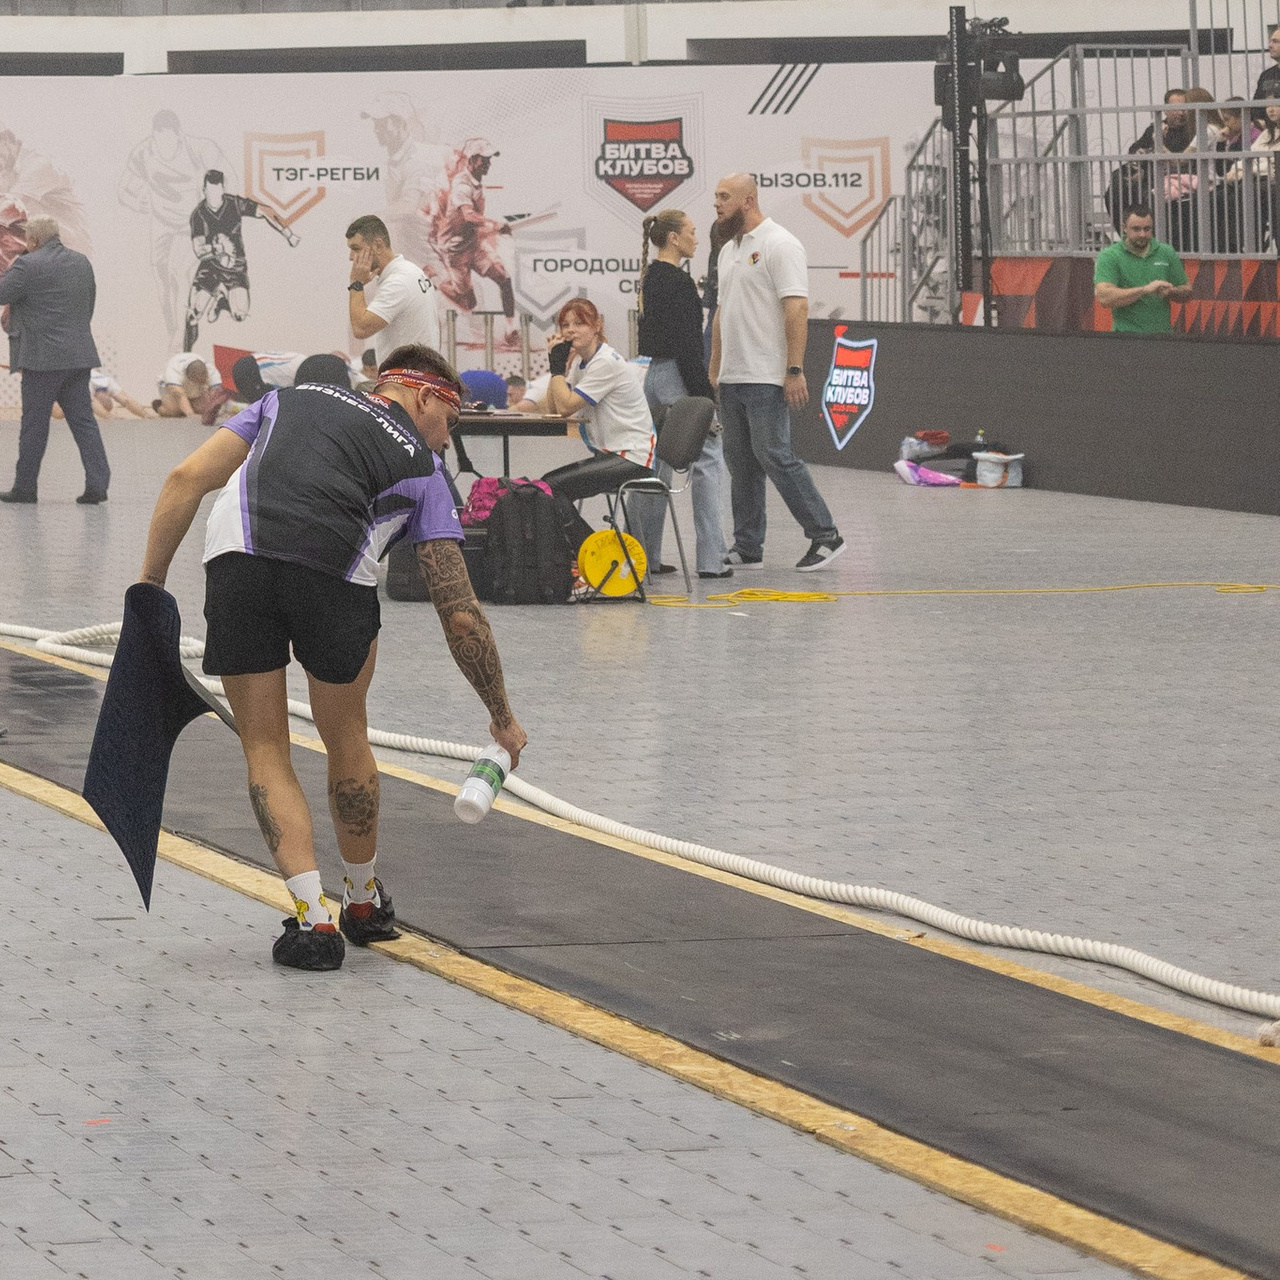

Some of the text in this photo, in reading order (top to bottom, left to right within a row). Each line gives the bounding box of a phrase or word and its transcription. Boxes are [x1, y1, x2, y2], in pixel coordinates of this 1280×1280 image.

[604, 142, 683, 159] БИТВА
[272, 166, 380, 182] ТЭГ-РЕГБИ
[598, 159, 690, 177] КЛУБОВ
[831, 368, 869, 388] БИТВА
[825, 385, 870, 406] КЛУБОВ
[295, 383, 416, 459] БИЗНЕС-ЛИГА
